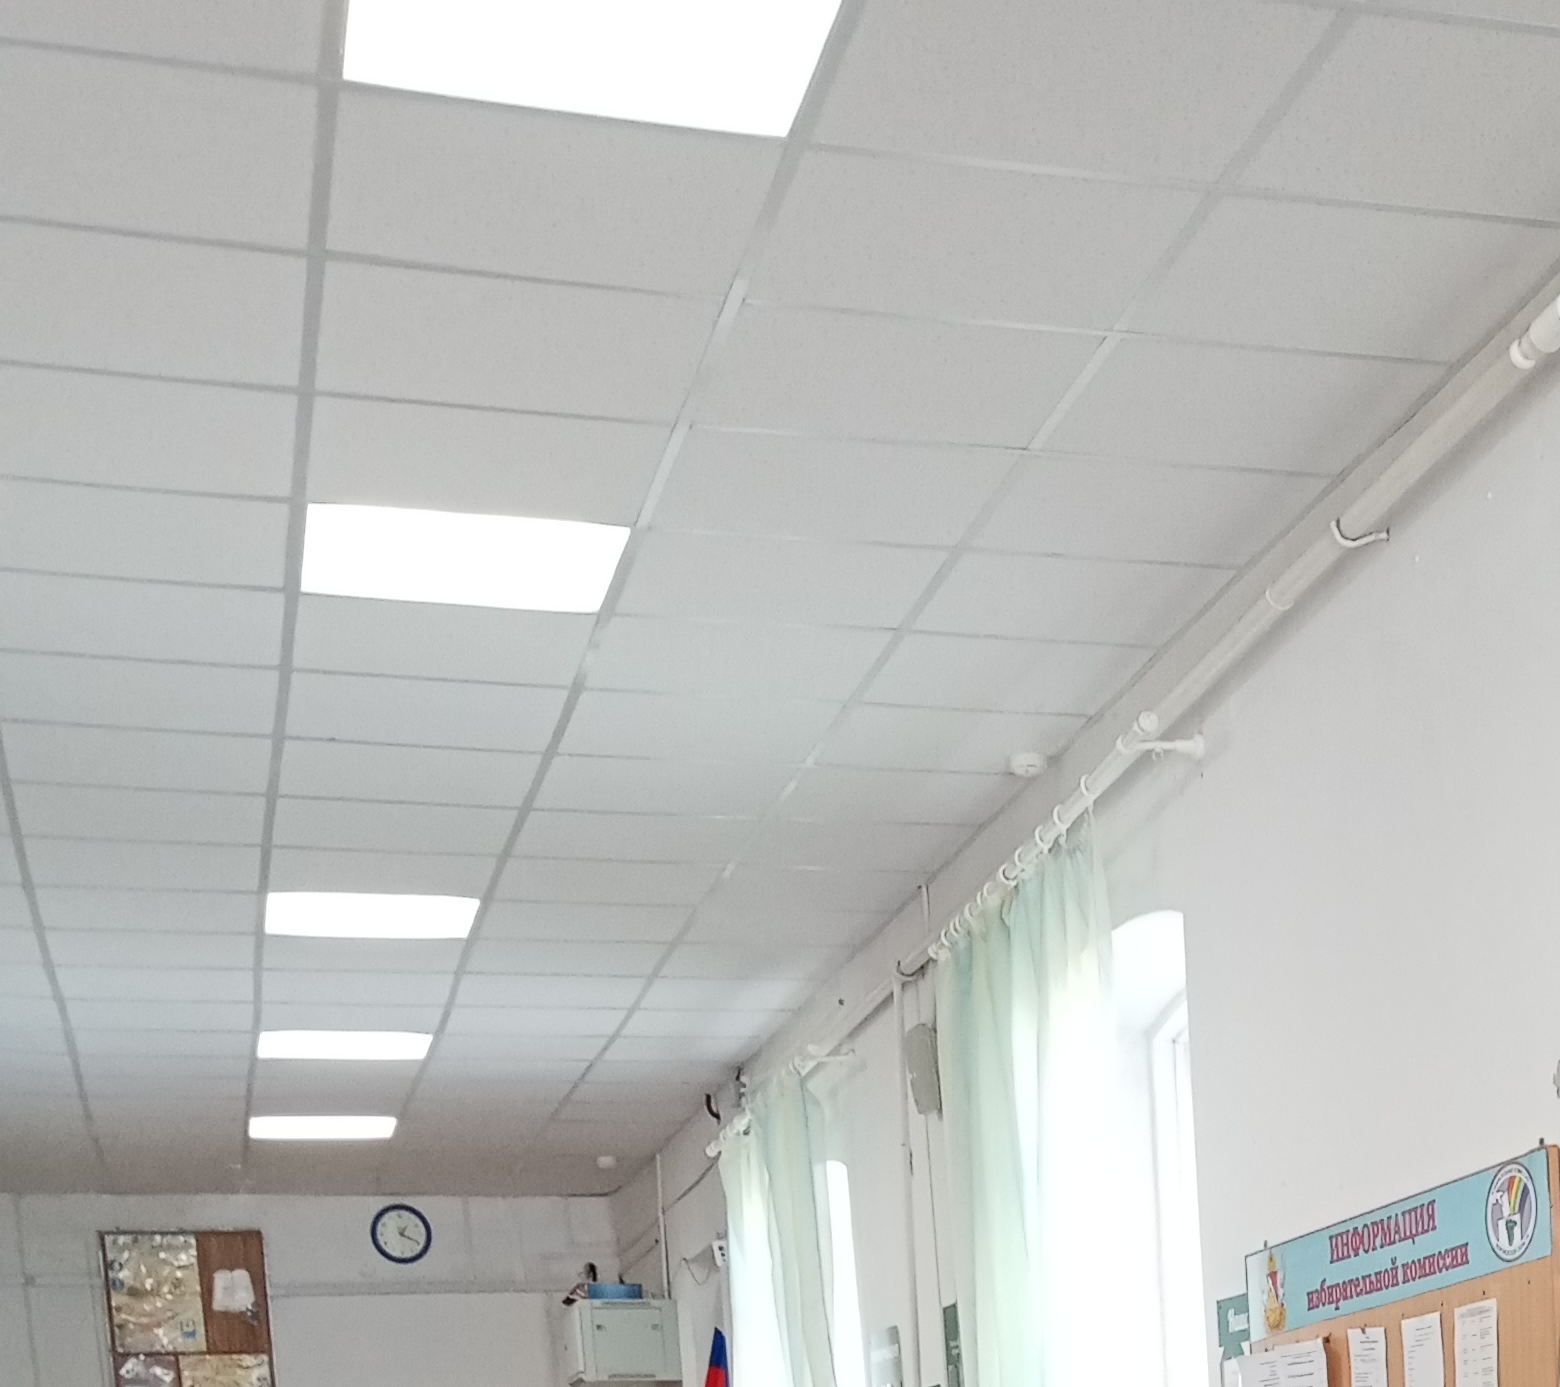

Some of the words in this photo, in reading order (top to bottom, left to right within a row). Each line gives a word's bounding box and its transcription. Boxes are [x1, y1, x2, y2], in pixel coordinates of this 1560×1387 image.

[1329, 1199, 1437, 1264] ИНФОРМАЦИЯ
[1306, 1256, 1400, 1312] избирательной
[1401, 1241, 1470, 1289] комиссии
